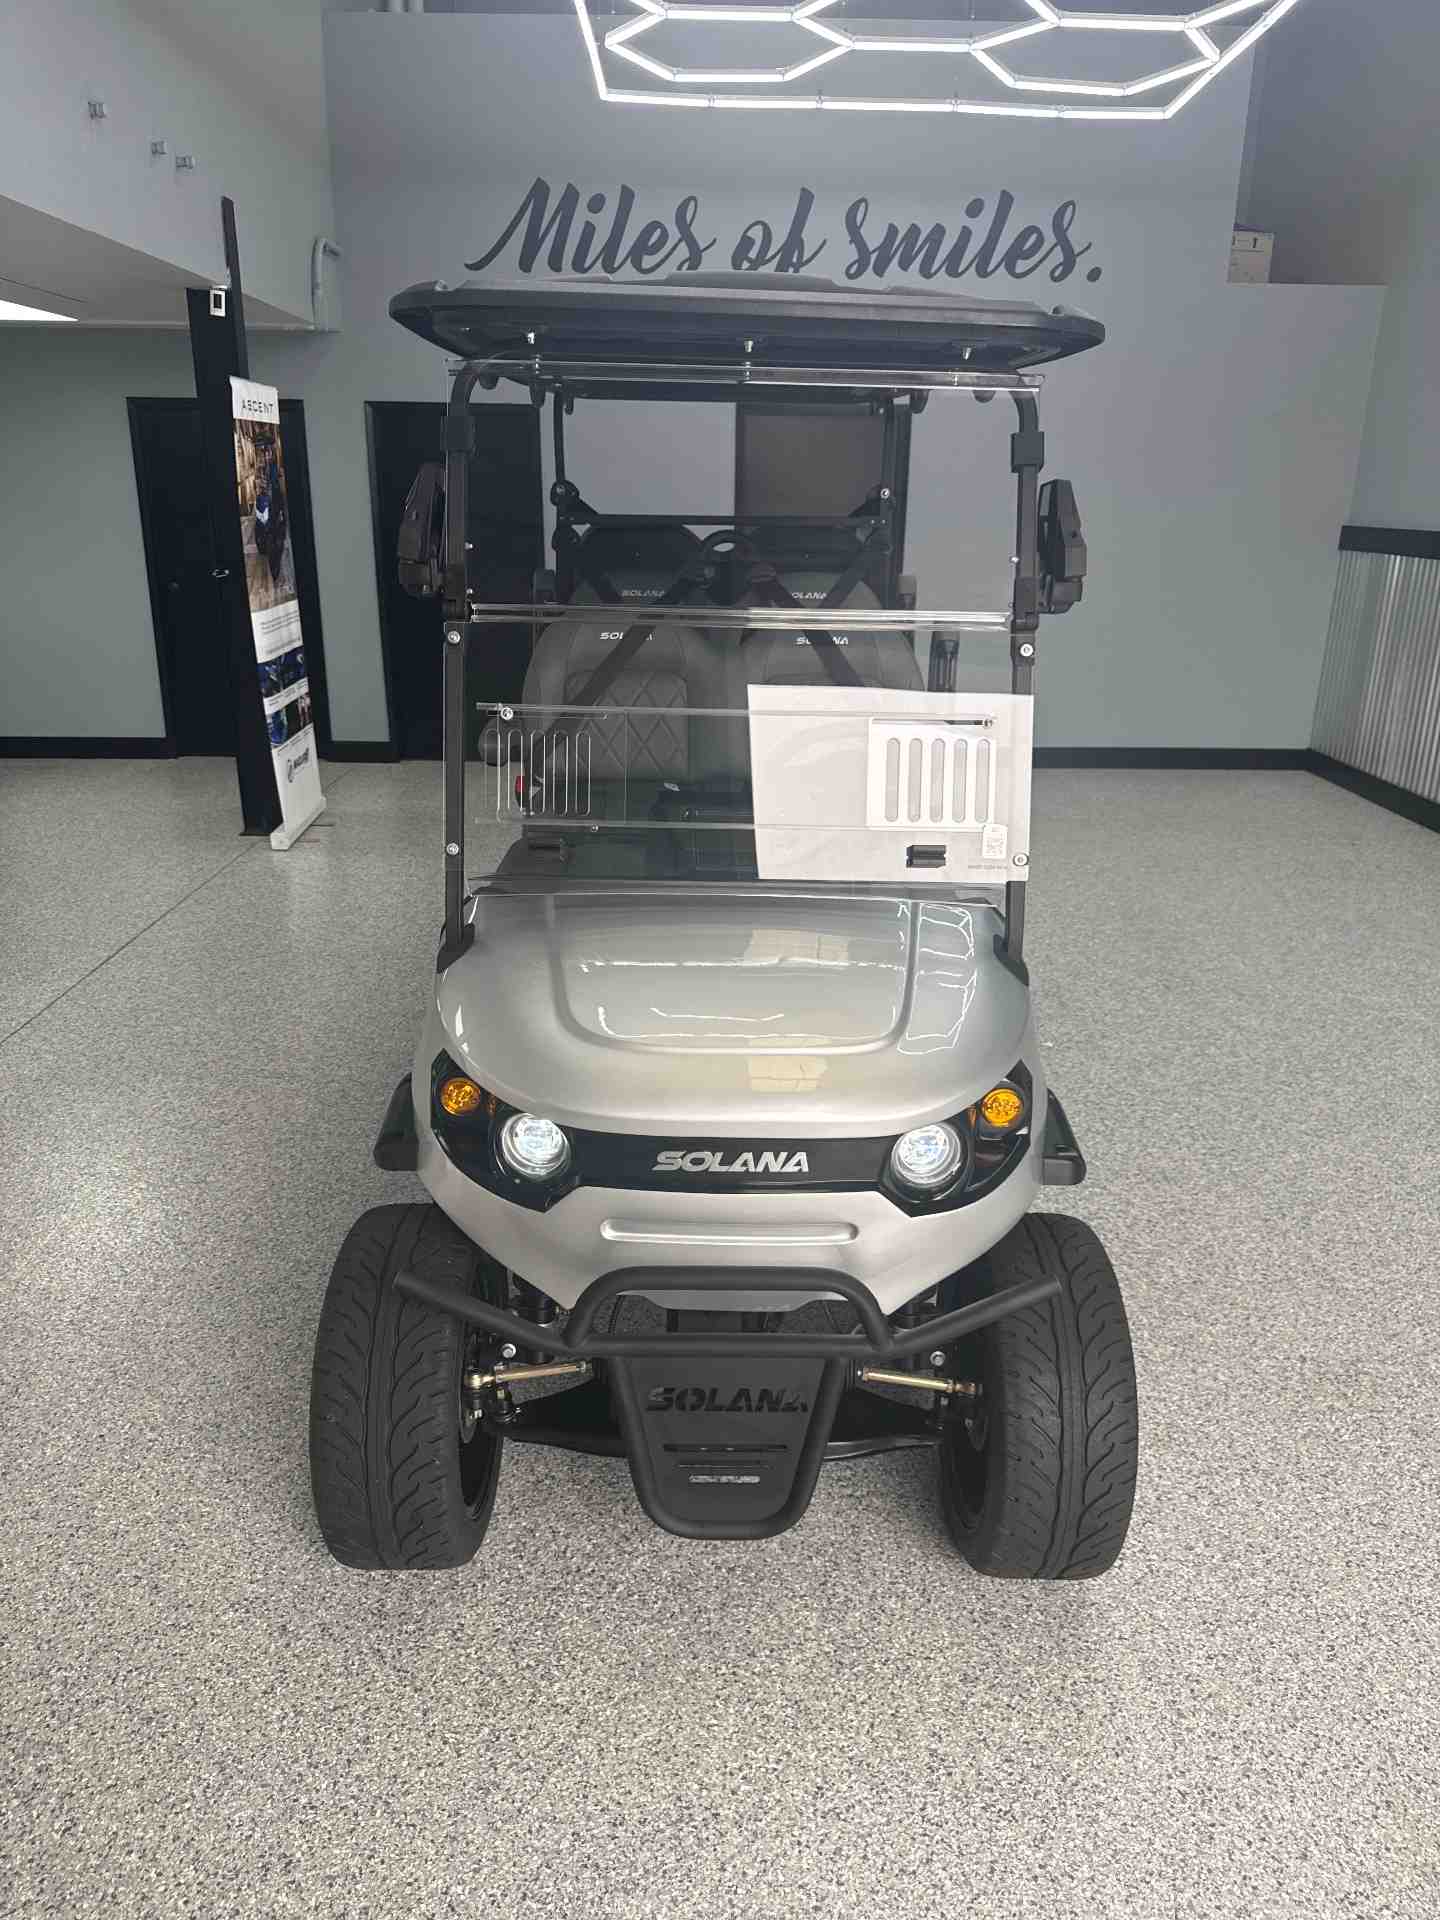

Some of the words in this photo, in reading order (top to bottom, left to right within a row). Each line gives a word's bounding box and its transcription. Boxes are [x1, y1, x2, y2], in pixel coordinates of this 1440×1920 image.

[464, 177, 716, 274] Miles
[844, 189, 1102, 283] smiles.
[240, 399, 274, 414] ASCENT
[652, 1150, 809, 1173] SOLANA
[646, 1387, 809, 1413] SOLANA
